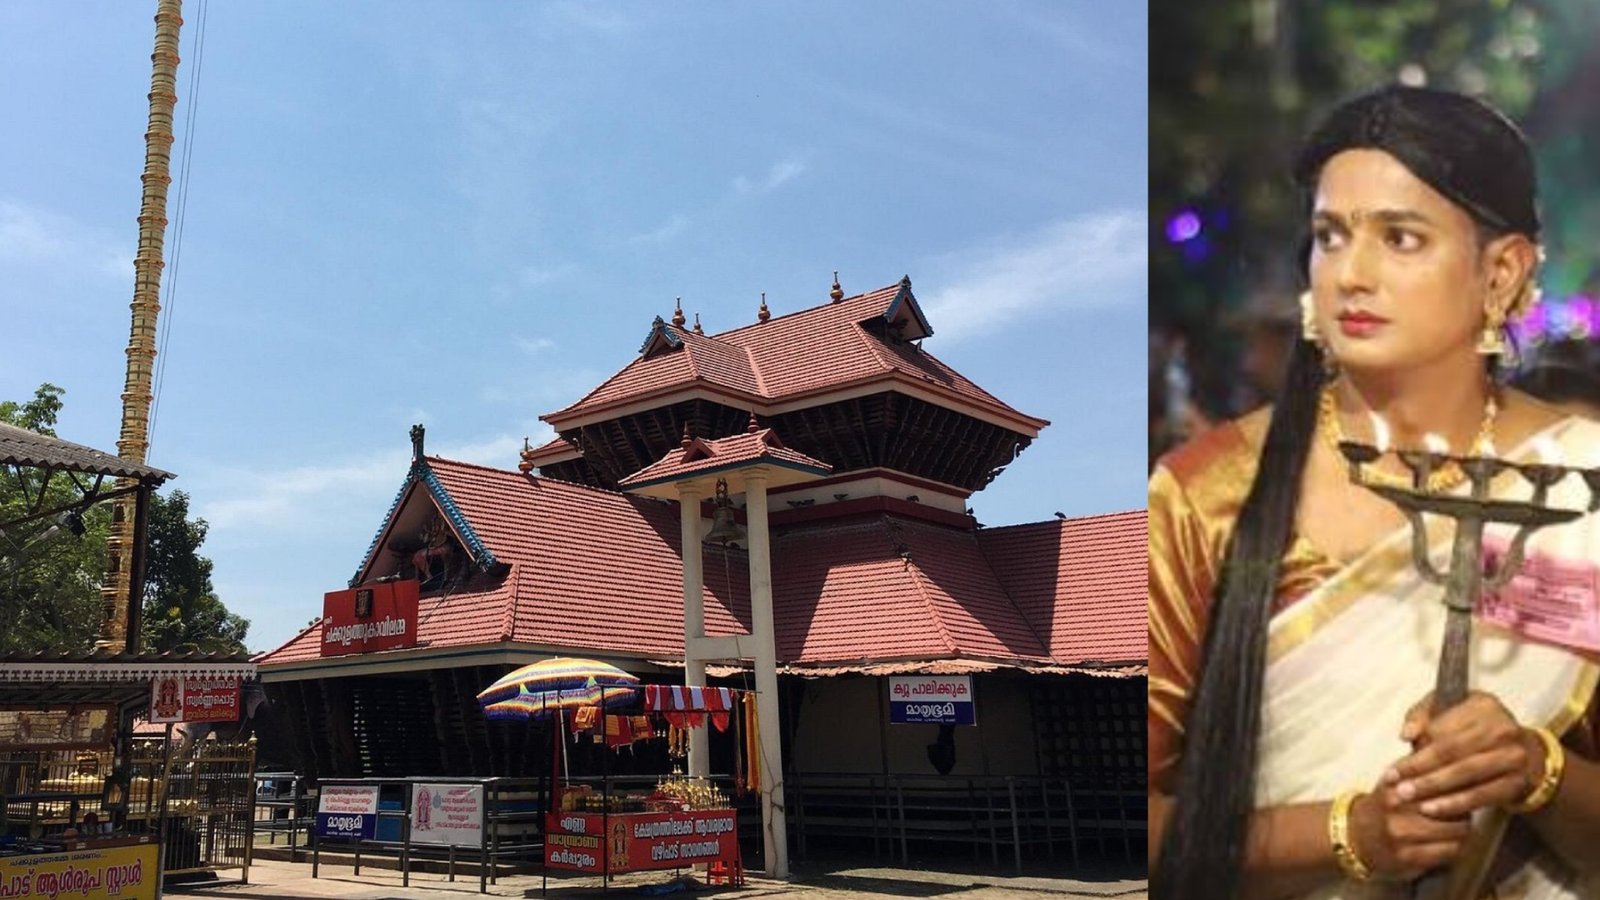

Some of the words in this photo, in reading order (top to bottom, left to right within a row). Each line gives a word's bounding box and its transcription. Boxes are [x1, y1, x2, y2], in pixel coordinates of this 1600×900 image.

[912, 680, 968, 698] പാലിക്കുക
[560, 817, 586, 833] എണ്ണ
[550, 848, 596, 868] കർപ്പൂരം
[651, 840, 680, 860] വഴിപാട്
[36, 865, 102, 898] ആൾരൂപ
